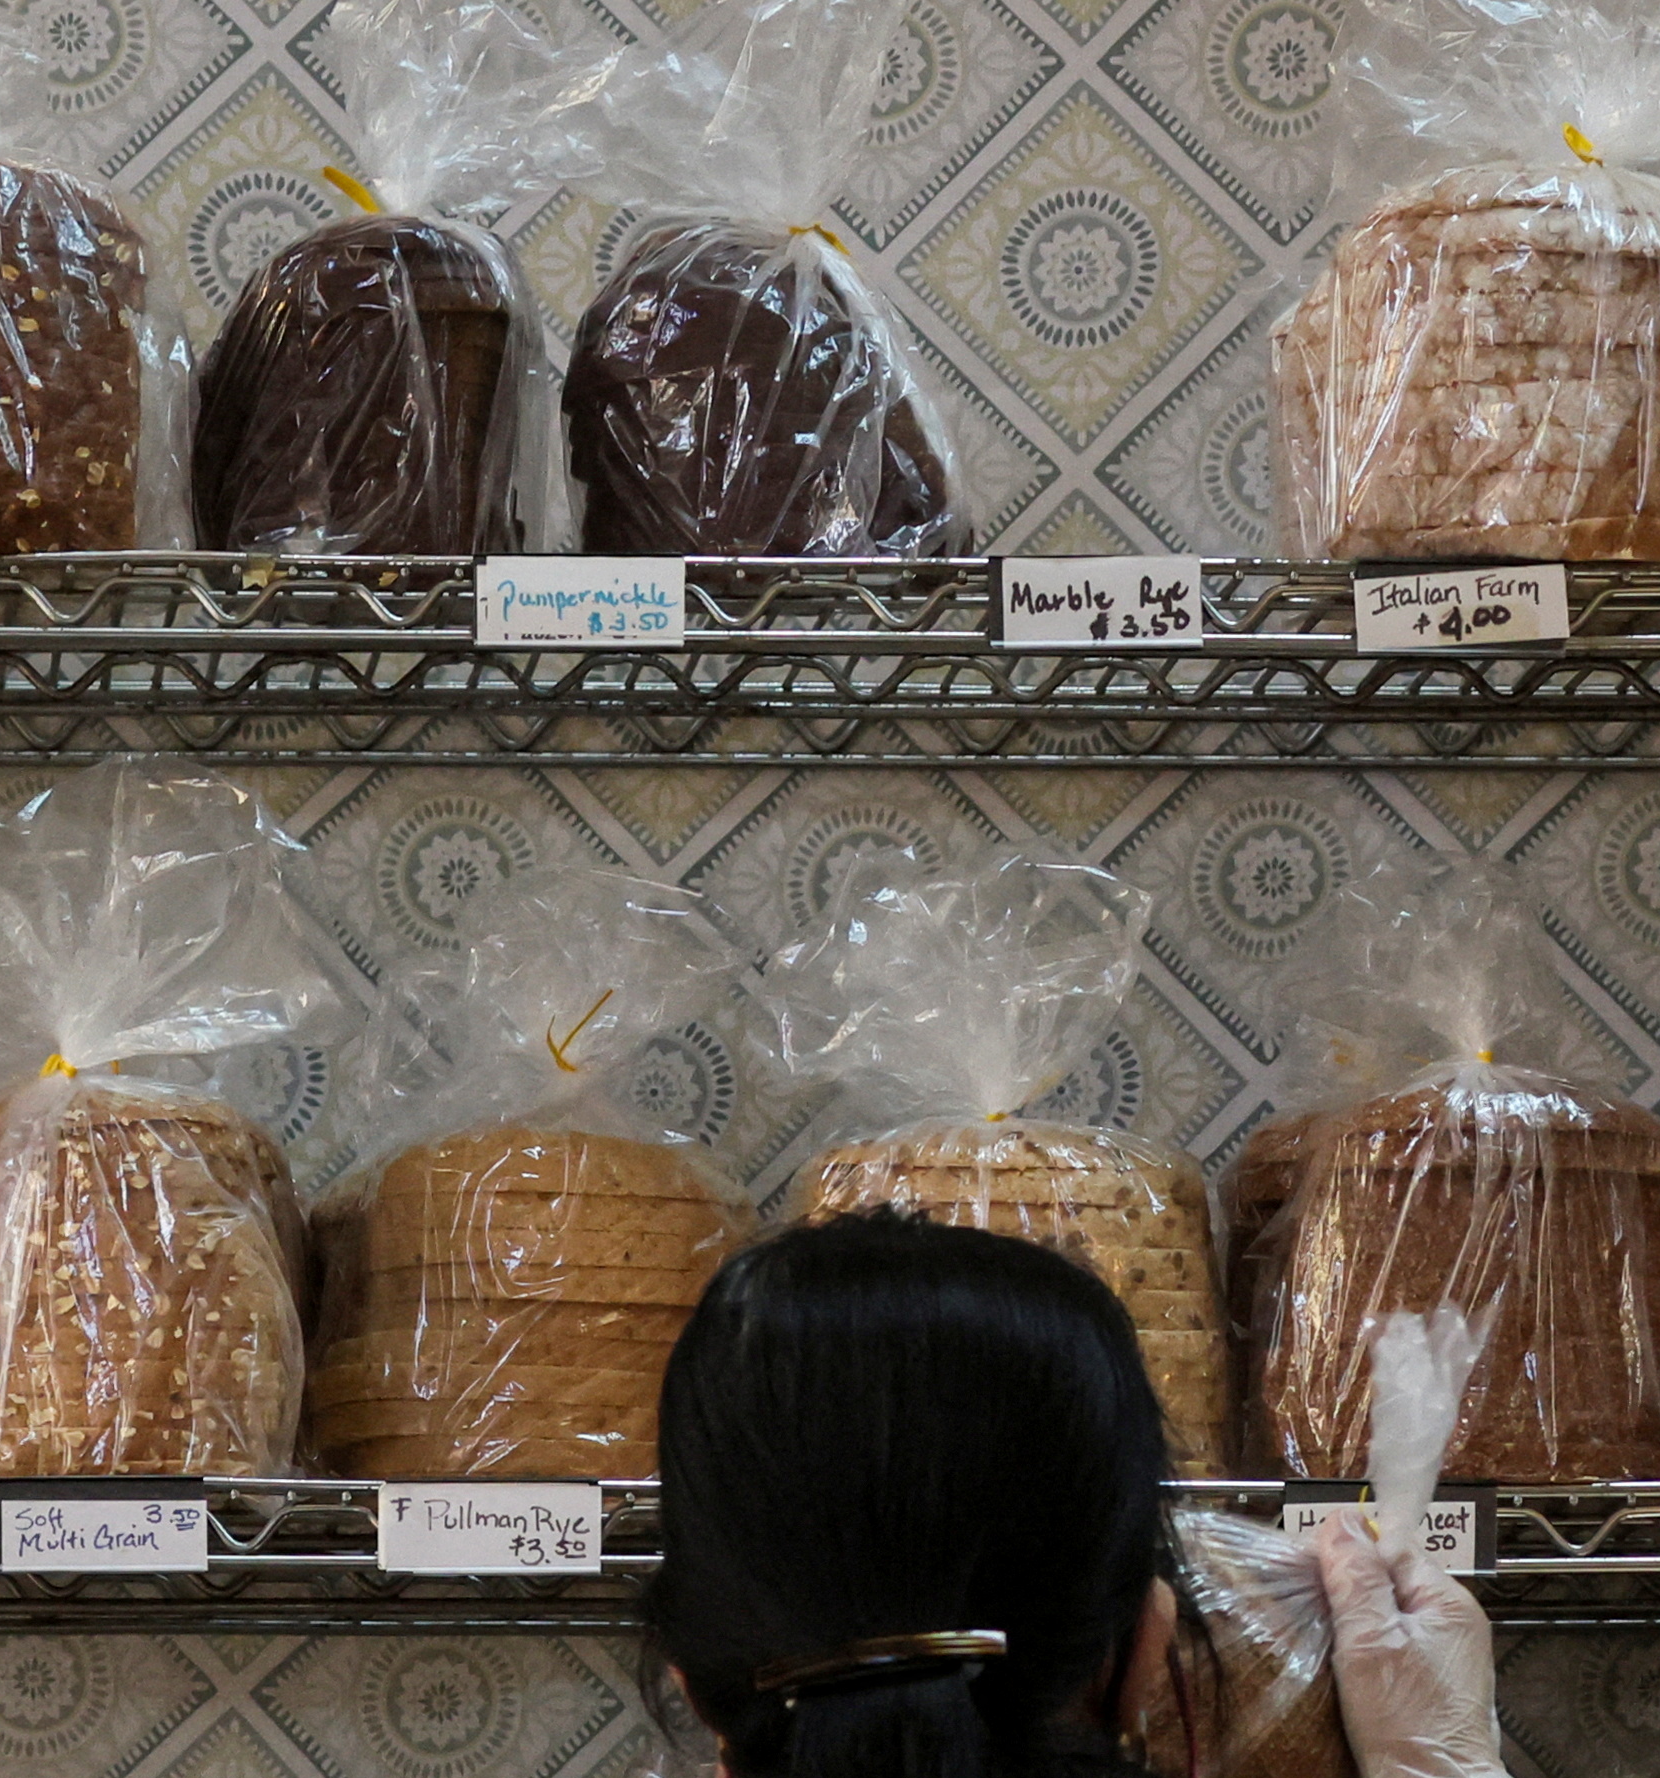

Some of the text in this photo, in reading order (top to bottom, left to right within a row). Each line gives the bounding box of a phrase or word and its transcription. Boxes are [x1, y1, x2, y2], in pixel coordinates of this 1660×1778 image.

[1010, 575, 1190, 615] Marble Rye
[1367, 574, 1540, 616] Italian Farm
[14, 1506, 64, 1534] Soft
[424, 1499, 528, 1532] Pullman
[530, 1506, 591, 1542] Rye
[1419, 1505, 1471, 1533] eat
[18, 1523, 160, 1557] Multi Grain
